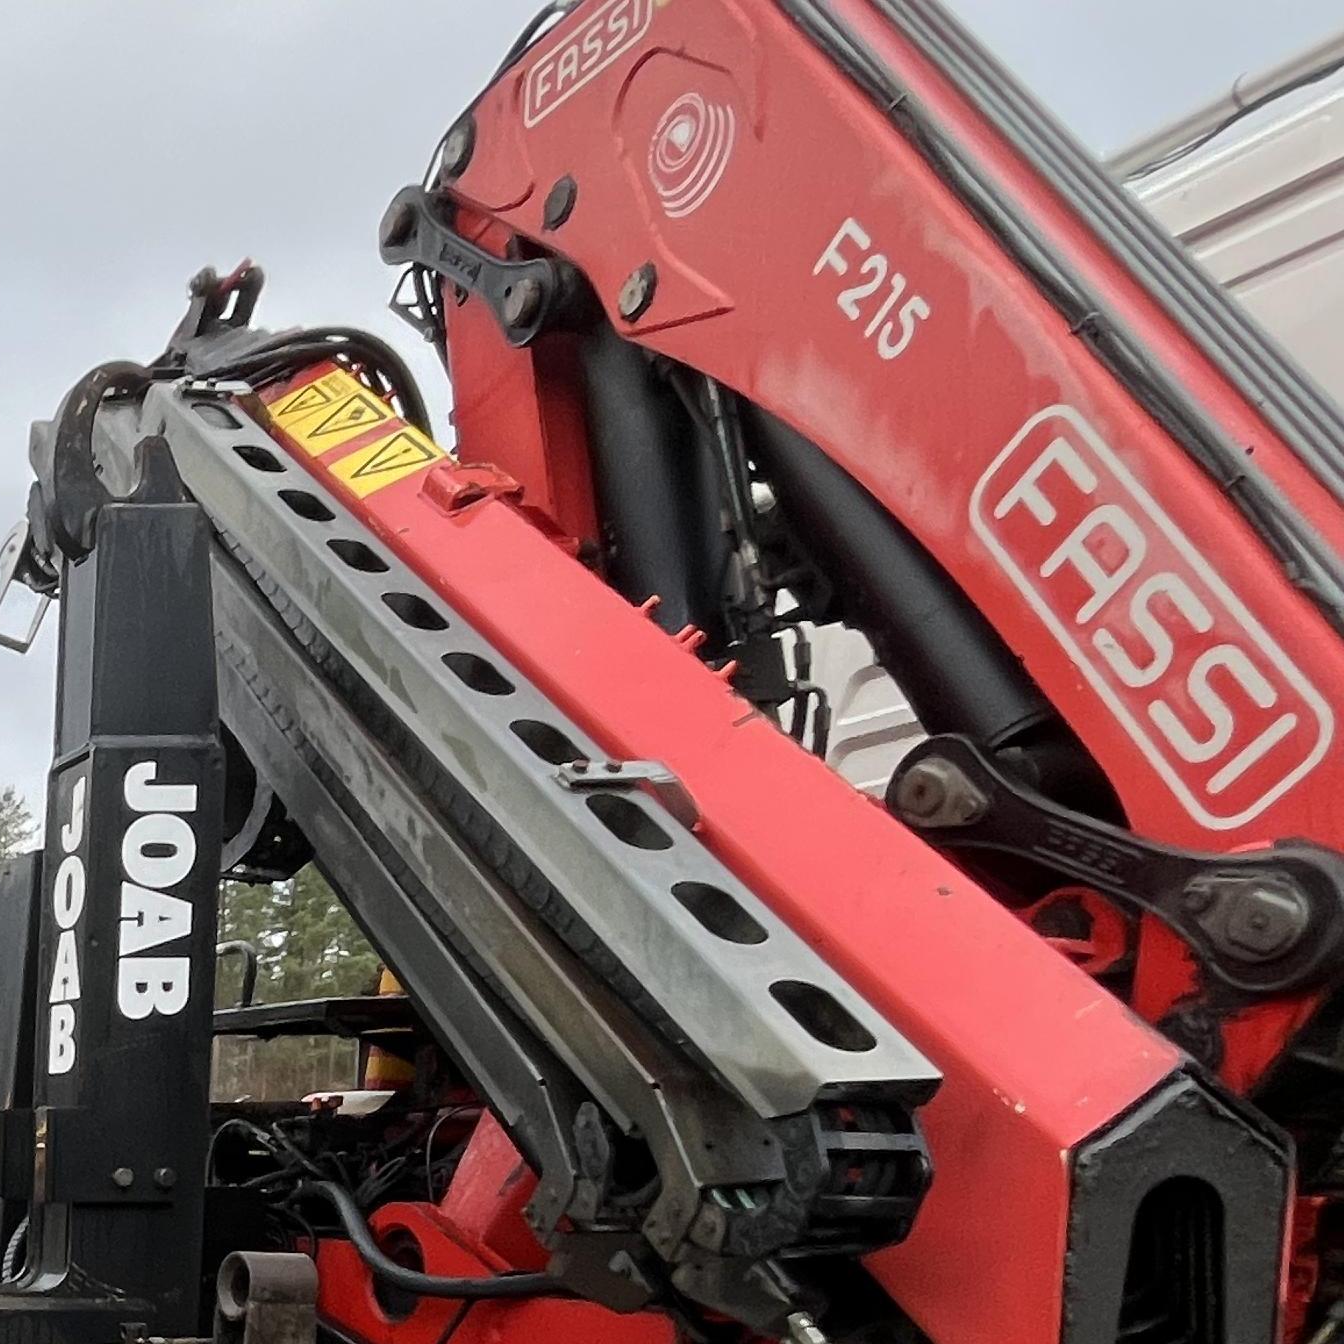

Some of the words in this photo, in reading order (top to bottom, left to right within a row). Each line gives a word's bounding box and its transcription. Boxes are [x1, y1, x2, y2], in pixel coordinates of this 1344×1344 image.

[812, 217, 931, 360] F215
[992, 436, 1298, 795] FASSI
[48, 776, 87, 1075] JOAB
[117, 760, 198, 1020] JOAB
